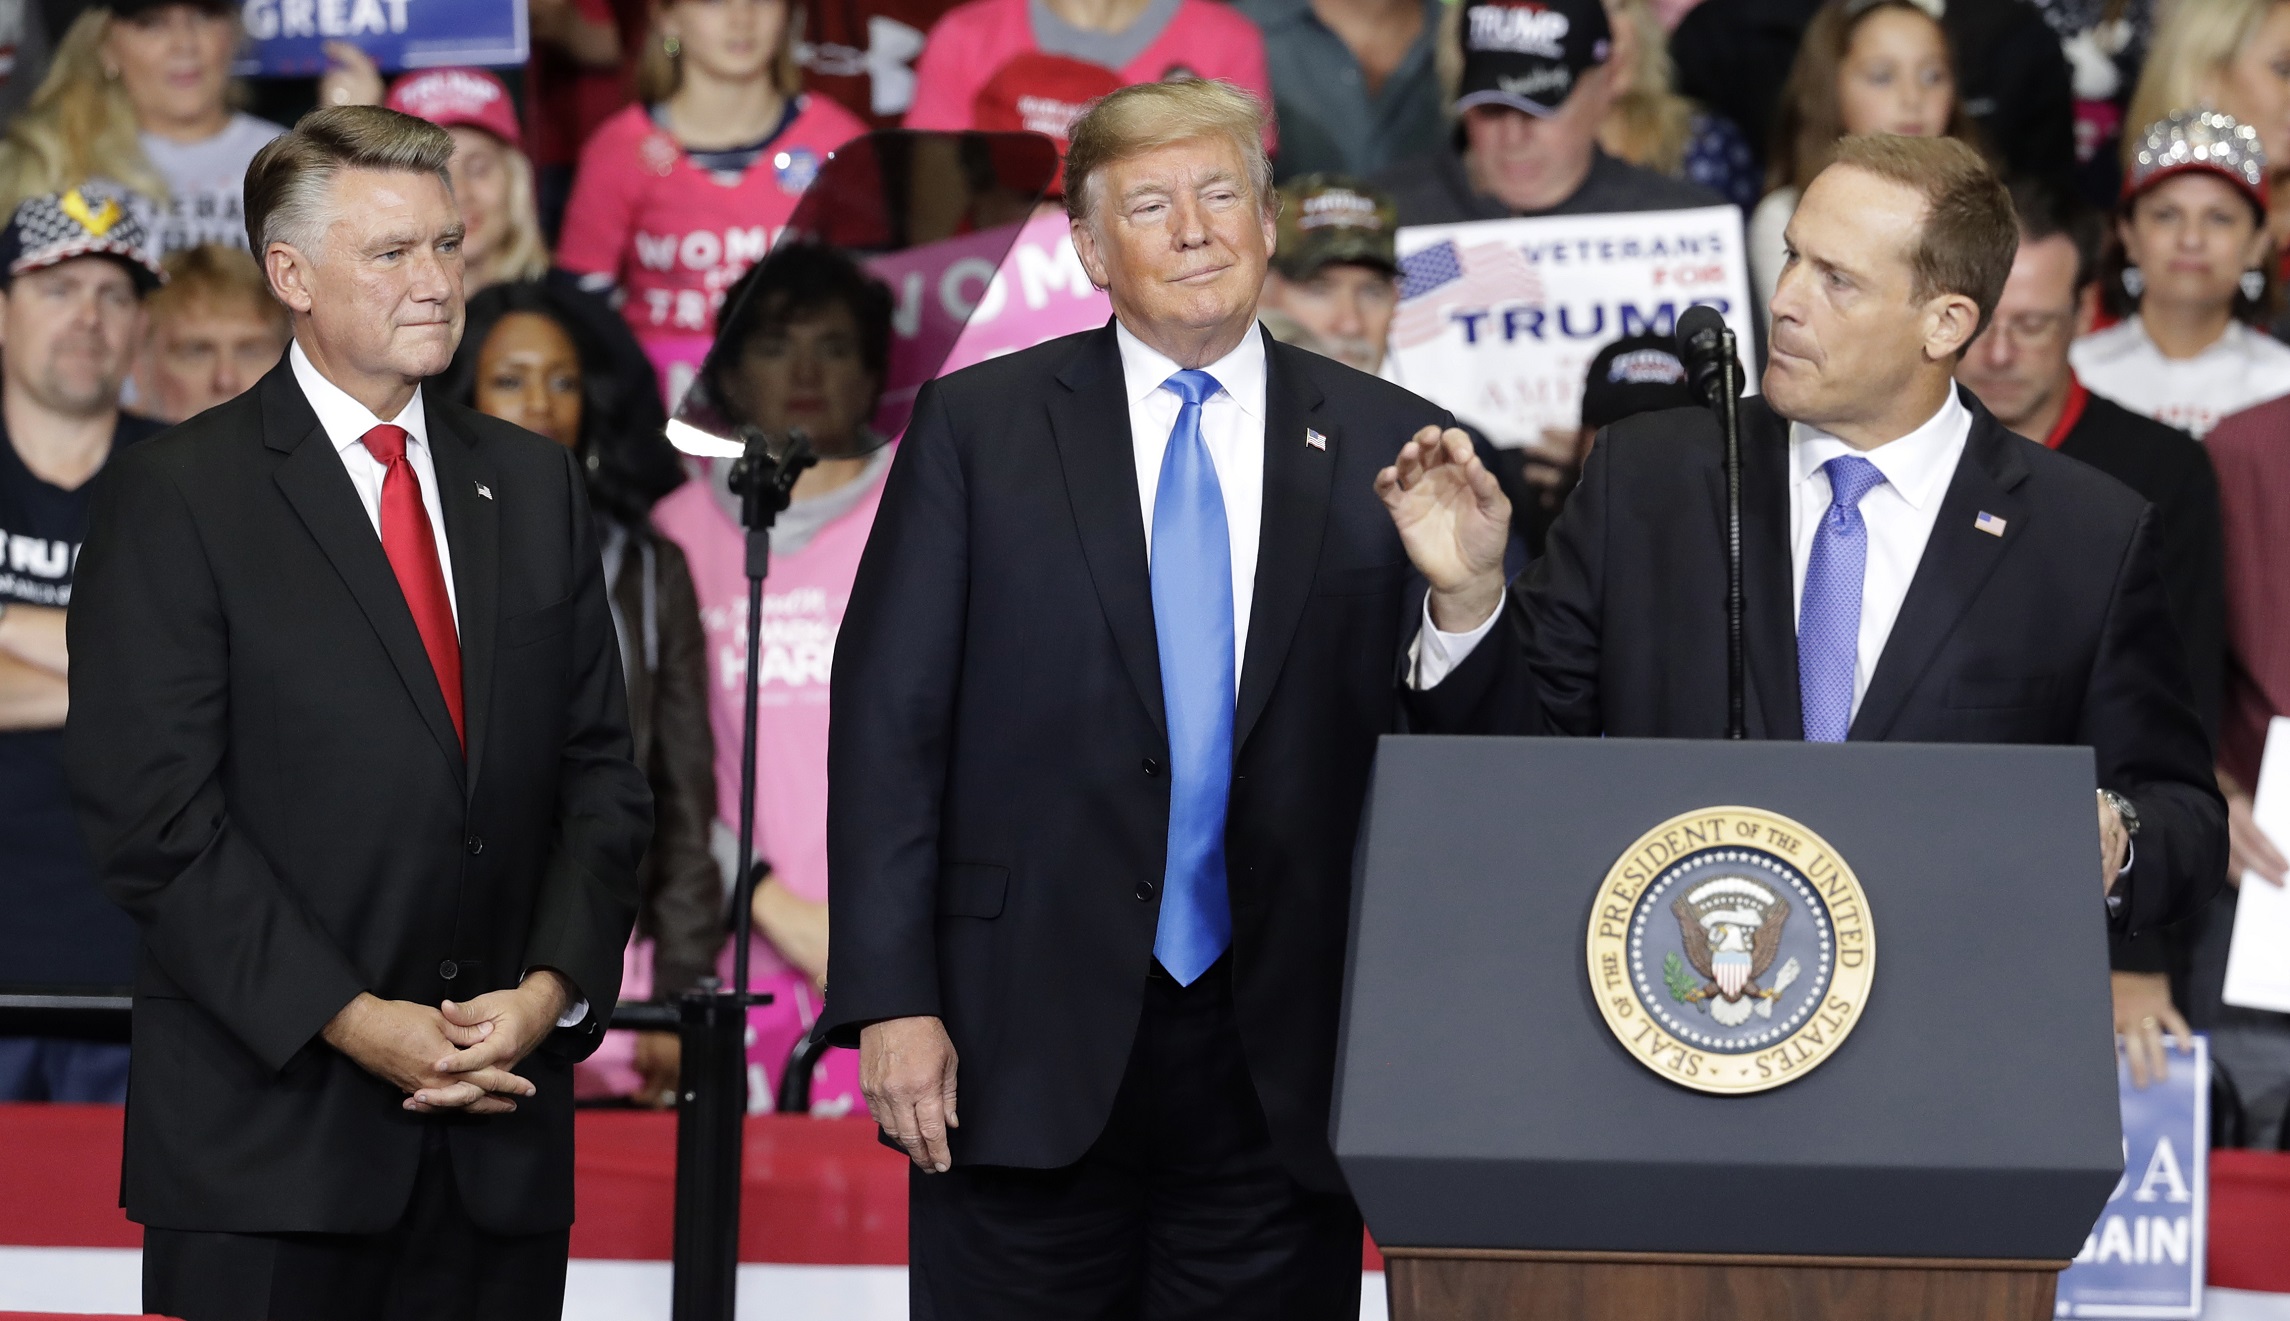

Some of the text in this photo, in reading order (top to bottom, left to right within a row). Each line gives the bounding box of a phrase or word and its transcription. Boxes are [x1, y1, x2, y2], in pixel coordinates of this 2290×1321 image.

[242, 0, 408, 40] GREAT
[634, 224, 798, 271] WOM
[1522, 234, 1723, 264] VETERANS
[1654, 264, 1724, 287] FOR
[1599, 817, 1864, 1079] SEAL OF THE PRESIDENT OF THE UNITED STATES
